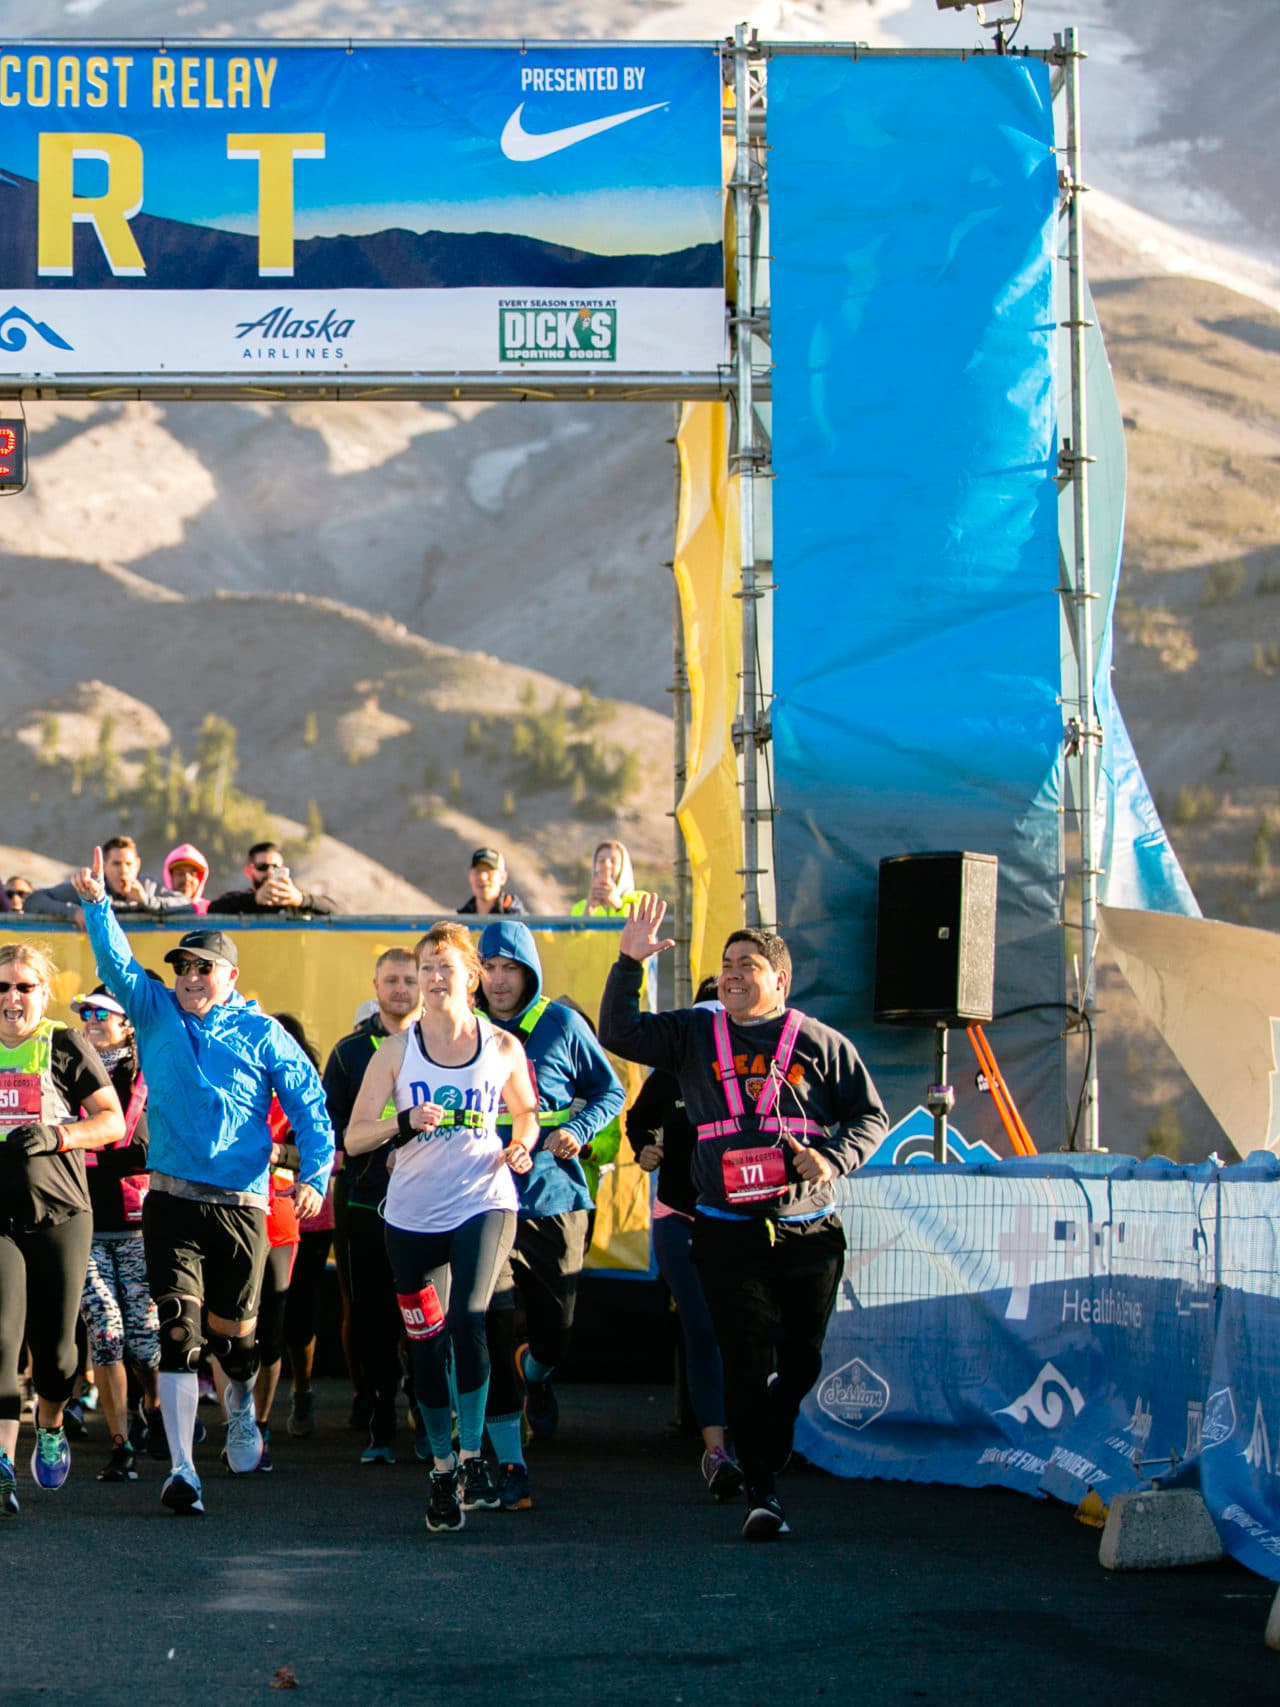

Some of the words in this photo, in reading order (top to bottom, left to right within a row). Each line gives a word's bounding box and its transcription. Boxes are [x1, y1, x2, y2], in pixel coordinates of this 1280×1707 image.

[0, 56, 134, 107] COAST
[152, 57, 278, 108] RELAY
[521, 67, 618, 92] PRESENTED
[623, 67, 646, 91] BY
[235, 306, 356, 343] Alaska
[243, 348, 344, 359] AIRLINES
[506, 349, 565, 359] SPORTING
[0, 1089, 19, 1108] 50
[741, 1164, 764, 1185] 171
[824, 1377, 883, 1408] Session
